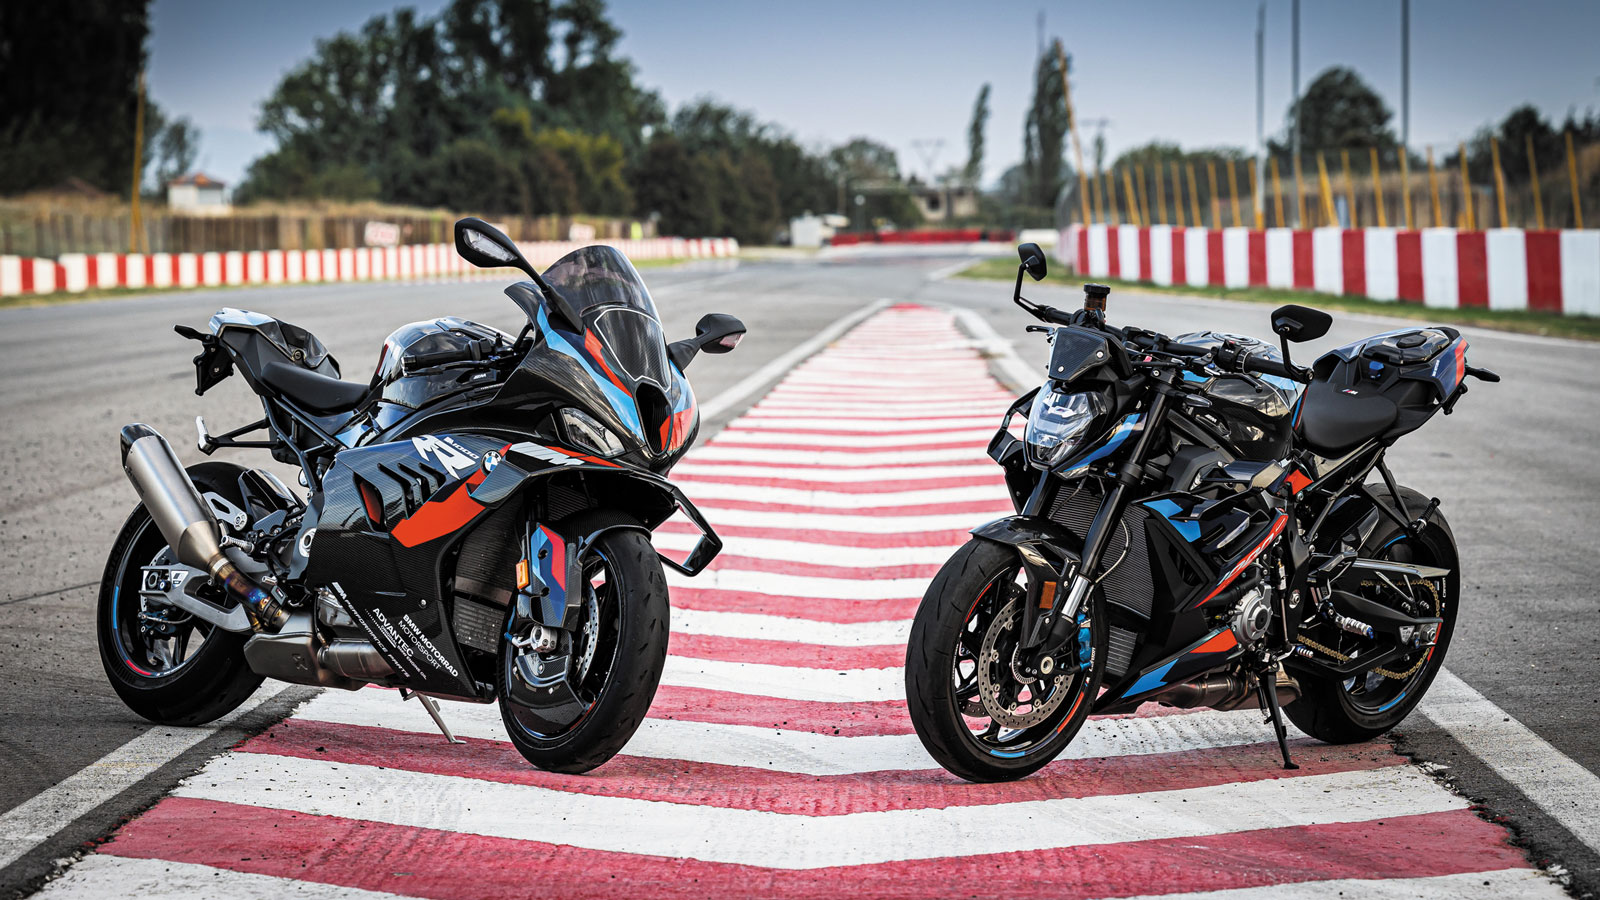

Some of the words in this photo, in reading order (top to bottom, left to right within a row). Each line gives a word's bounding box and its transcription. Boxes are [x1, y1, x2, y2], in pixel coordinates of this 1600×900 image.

[345, 599, 389, 653] PERFORMANCE
[388, 654, 411, 678] PARTS
[372, 607, 414, 657] ADVANTEC
[398, 620, 442, 670] MOTORSPORT
[402, 613, 422, 636] BMW
[420, 634, 459, 678] MOTORRAD
